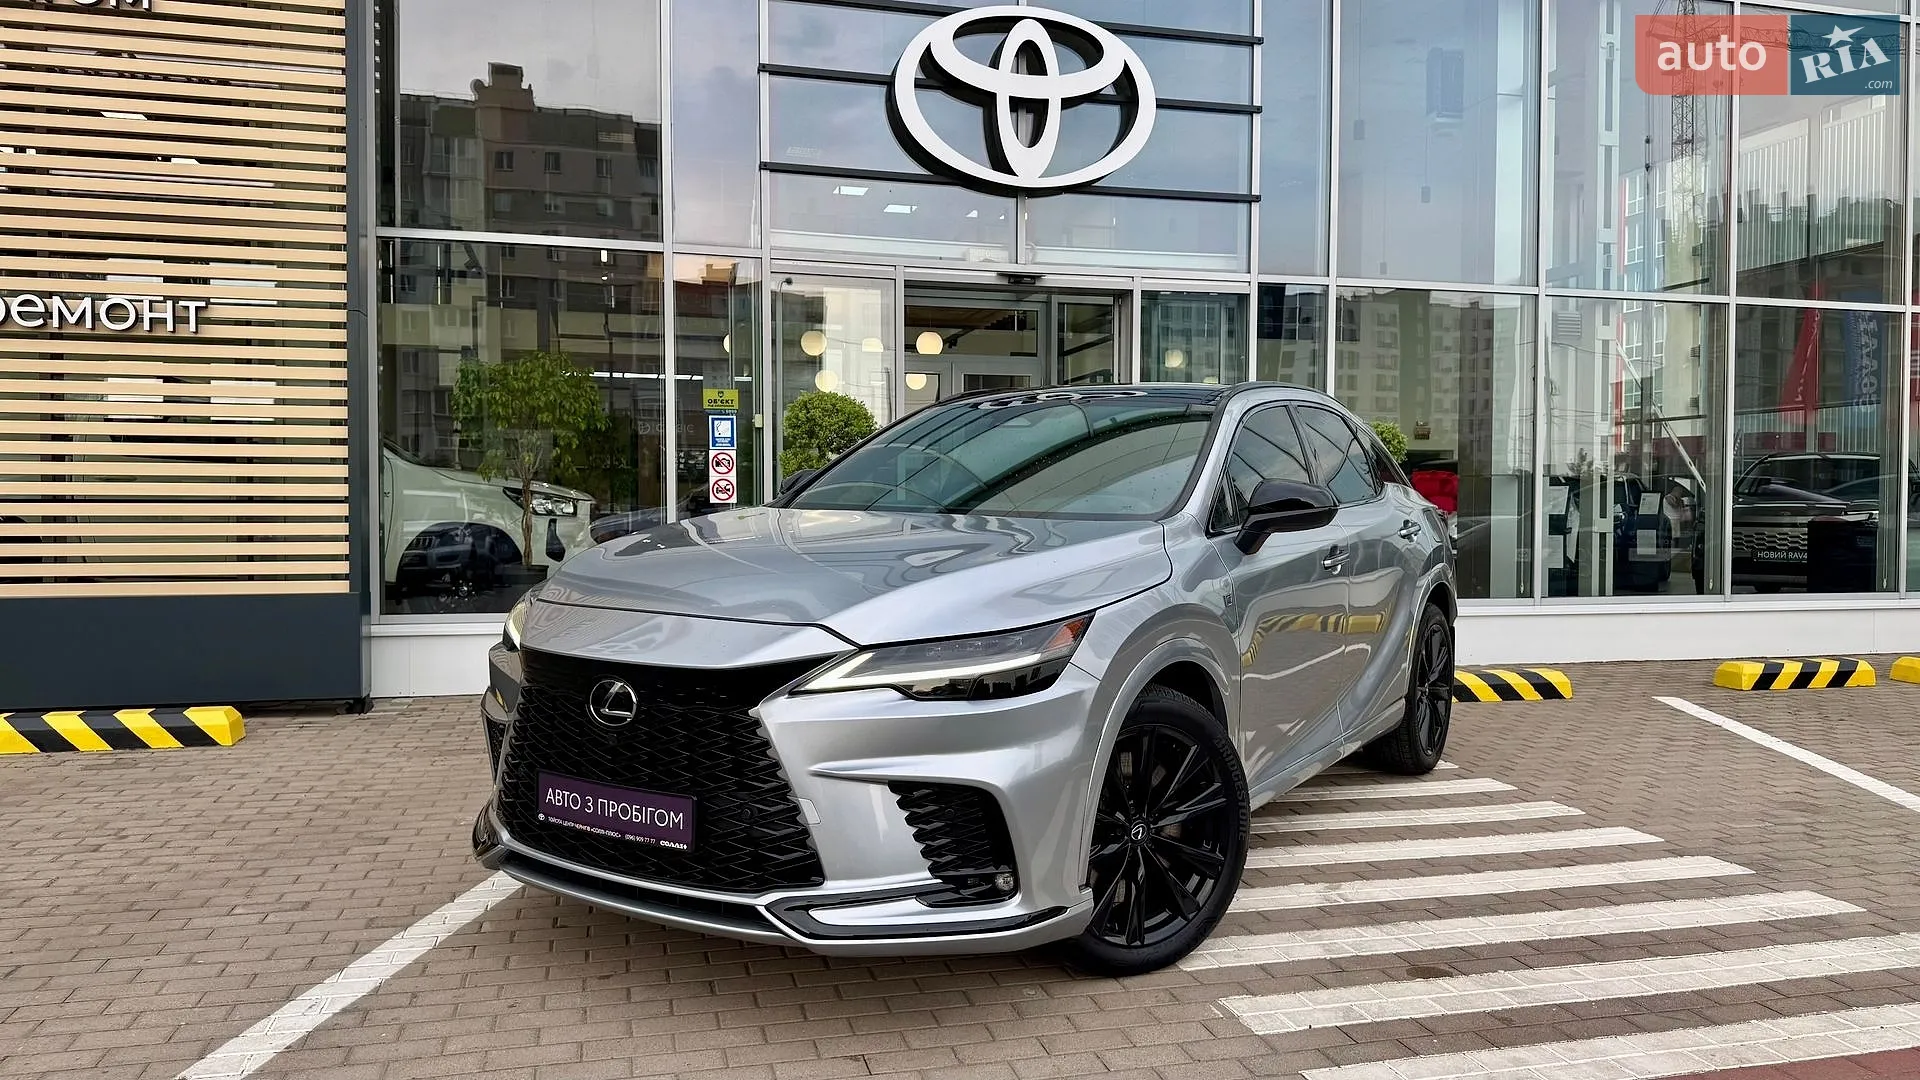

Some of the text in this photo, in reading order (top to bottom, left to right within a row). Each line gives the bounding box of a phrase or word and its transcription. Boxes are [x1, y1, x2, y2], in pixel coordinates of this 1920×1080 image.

[0, 293, 206, 332] емонт
[1757, 550, 1787, 559] НОВИЙ
[545, 787, 683, 830] АВТО З ПРОБІГОМ
